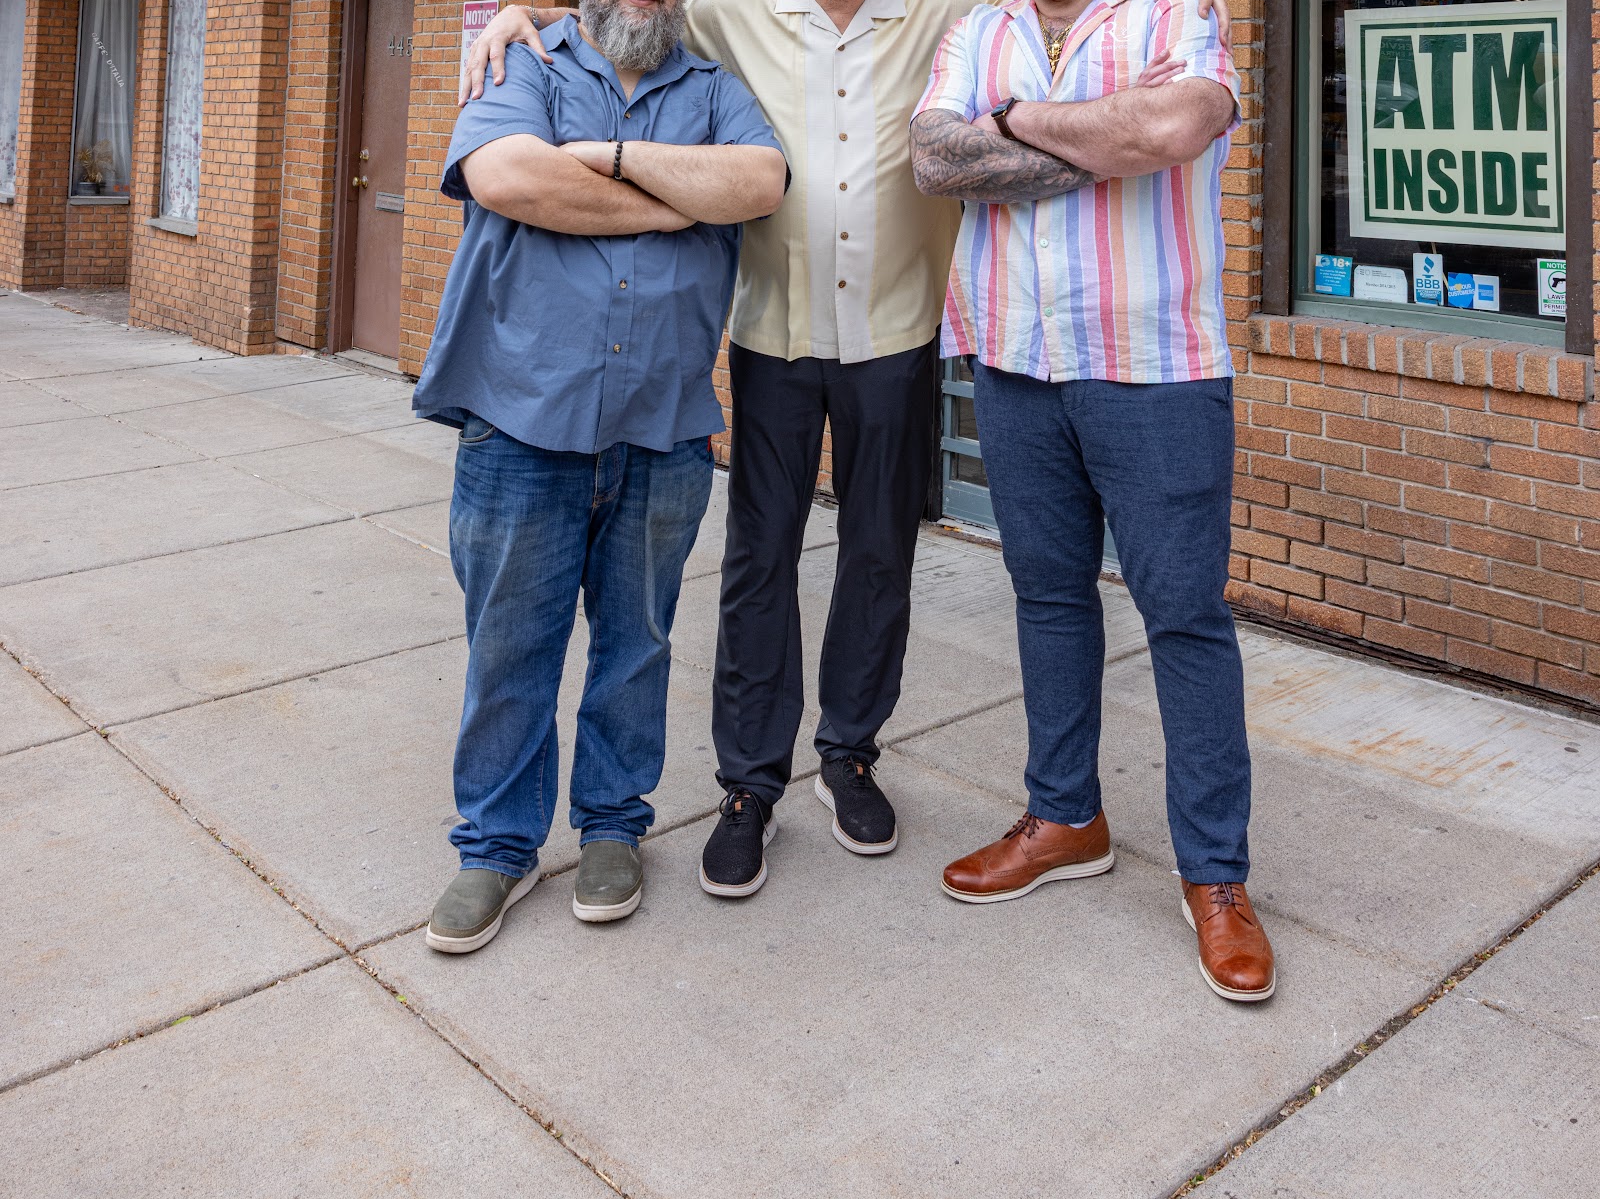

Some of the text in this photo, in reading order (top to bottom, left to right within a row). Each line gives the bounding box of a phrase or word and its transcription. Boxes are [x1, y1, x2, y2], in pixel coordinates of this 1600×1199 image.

[1373, 31, 1548, 131] ATM
[1373, 149, 1550, 218] INSIDE
[1332, 258, 1350, 267] 18+
[1416, 278, 1440, 289] BBB
